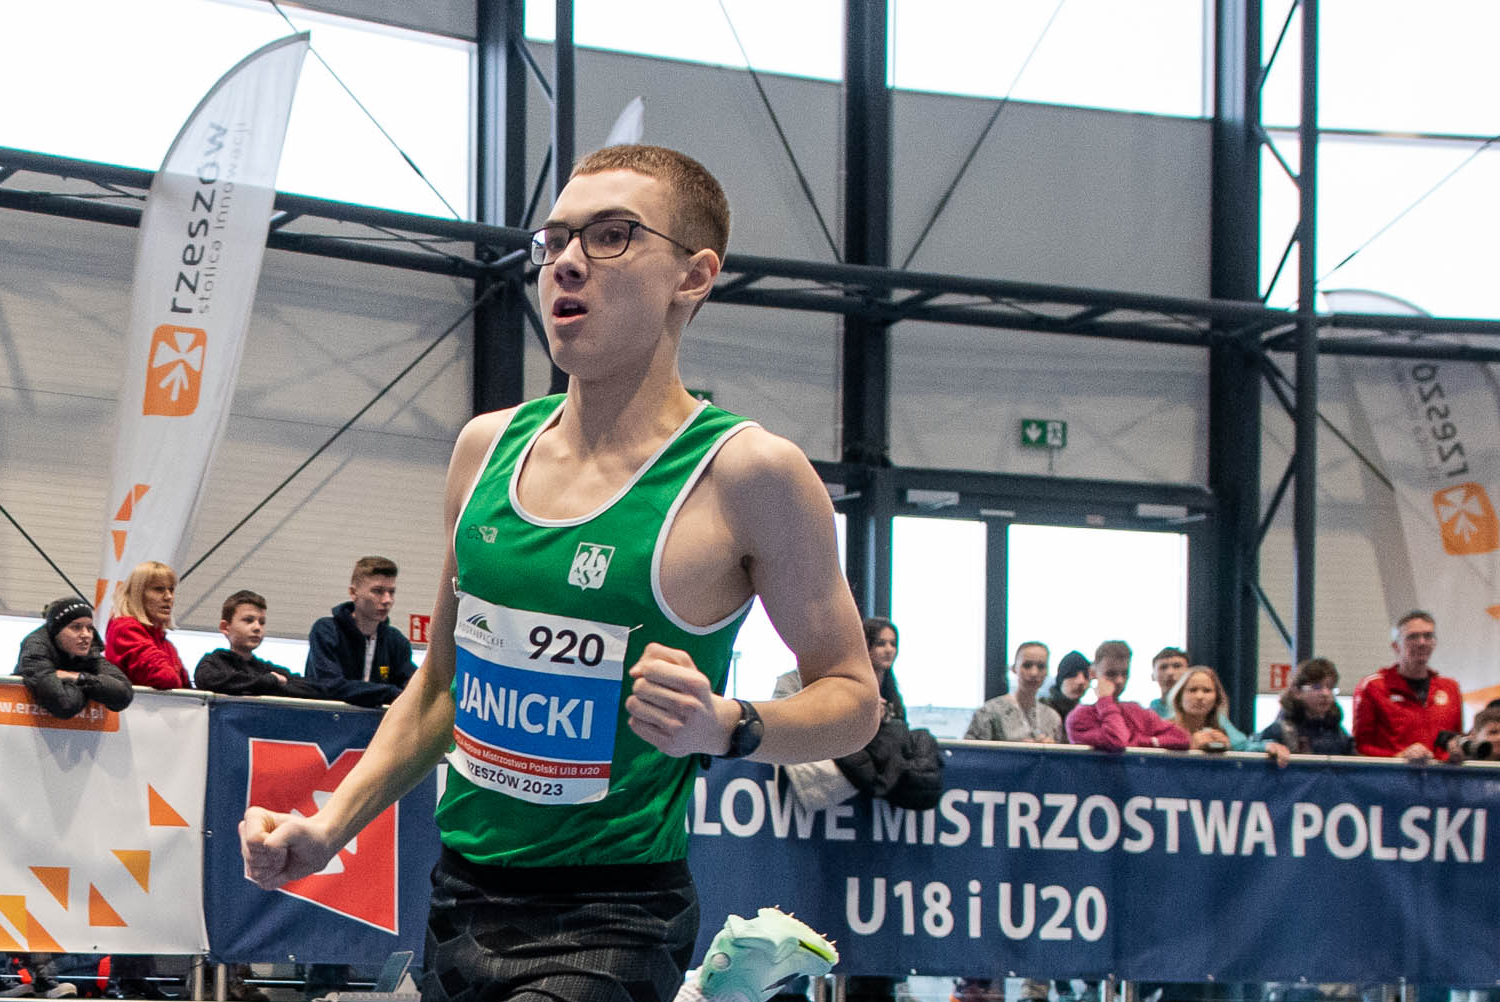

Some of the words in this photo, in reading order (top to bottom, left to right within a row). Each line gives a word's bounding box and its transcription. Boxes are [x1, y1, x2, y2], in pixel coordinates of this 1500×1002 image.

[198, 240, 222, 314] stolica
[528, 625, 605, 667] 920
[459, 672, 594, 740] JANICKI
[522, 779, 564, 797] 2023
[529, 762, 558, 775] Polski
[560, 767, 577, 776] U18
[579, 766, 601, 775] U20
[685, 776, 856, 841] LOWE
[872, 788, 1277, 858] MISTRZOSTWA
[1291, 801, 1488, 863] POLSKI
[846, 875, 955, 939] U18
[967, 879, 983, 939] i
[998, 881, 1108, 942] U20
